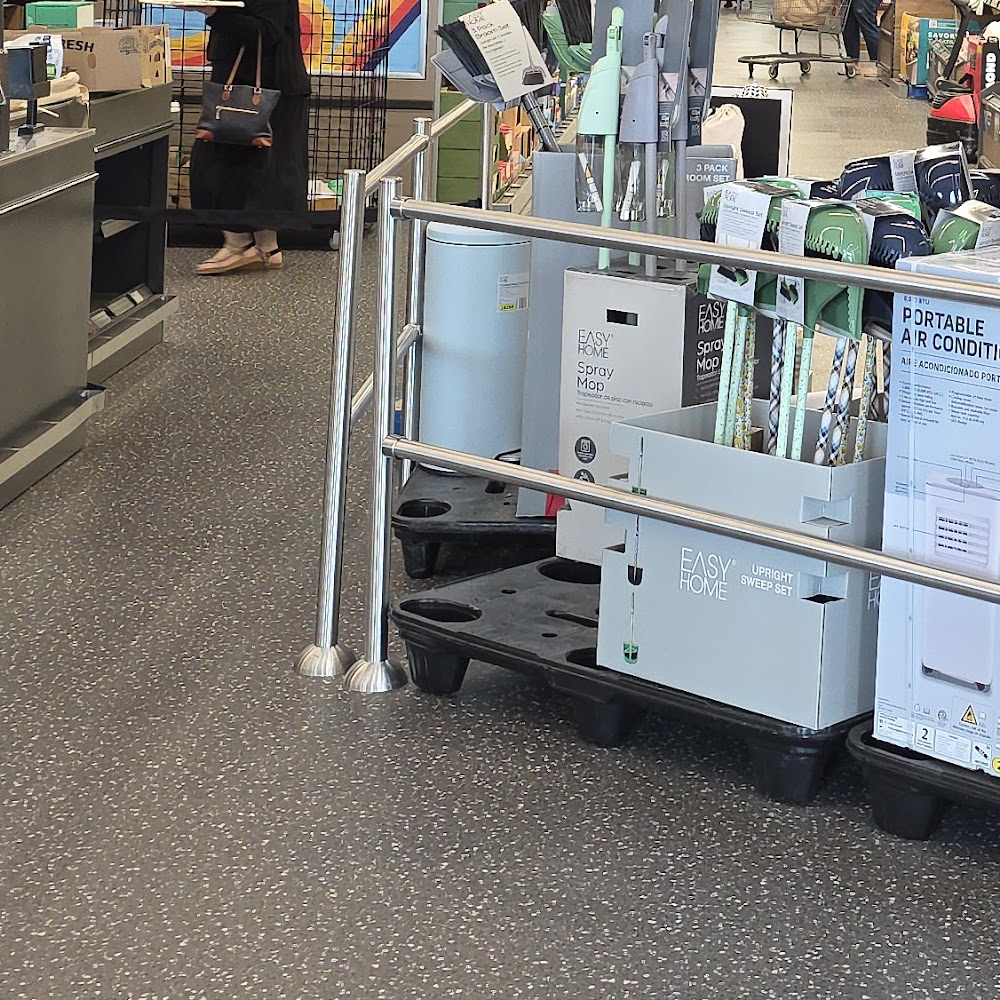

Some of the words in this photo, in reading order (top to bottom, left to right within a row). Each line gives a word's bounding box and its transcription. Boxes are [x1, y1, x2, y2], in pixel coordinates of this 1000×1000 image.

[928, 31, 957, 39] SAVOR
[62, 39, 95, 53] RESH
[696, 163, 702, 172] 3
[704, 164, 728, 172] PACK
[698, 301, 726, 321] EASY
[697, 317, 724, 335] HOME
[903, 306, 985, 337] PORTABLE
[578, 329, 611, 347] EASY
[901, 327, 927, 348] AIR
[577, 344, 609, 359] HOME
[577, 361, 614, 380] Spray
[696, 356, 720, 373] Mop
[918, 360, 980, 379] ACONDICIONADO
[576, 376, 605, 392] Mop
[680, 547, 732, 581] EASY
[751, 563, 794, 585] UPRIGHT
[680, 570, 728, 602] HOME
[740, 575, 773, 592] SWEEP
[773, 582, 793, 597] SET
[921, 728, 929, 741] 2
